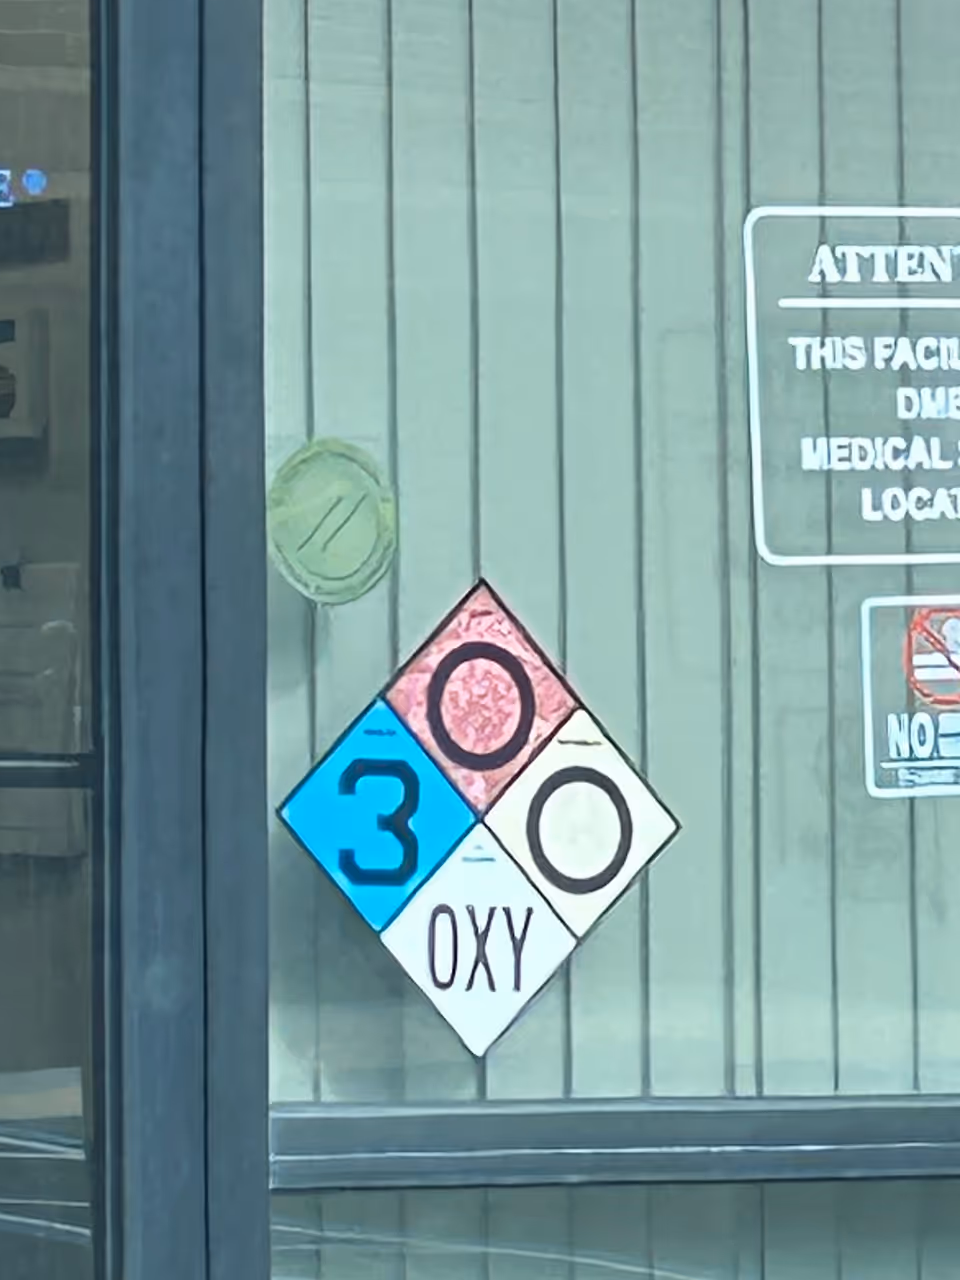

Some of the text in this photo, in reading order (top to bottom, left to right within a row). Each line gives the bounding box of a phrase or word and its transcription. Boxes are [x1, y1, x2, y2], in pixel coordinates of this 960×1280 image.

[788, 336, 867, 370] THIS
[800, 436, 953, 471] MEDICAL
[426, 641, 536, 772] 0
[886, 711, 936, 760] NO
[339, 758, 421, 887] 3
[427, 903, 534, 993] OXY
